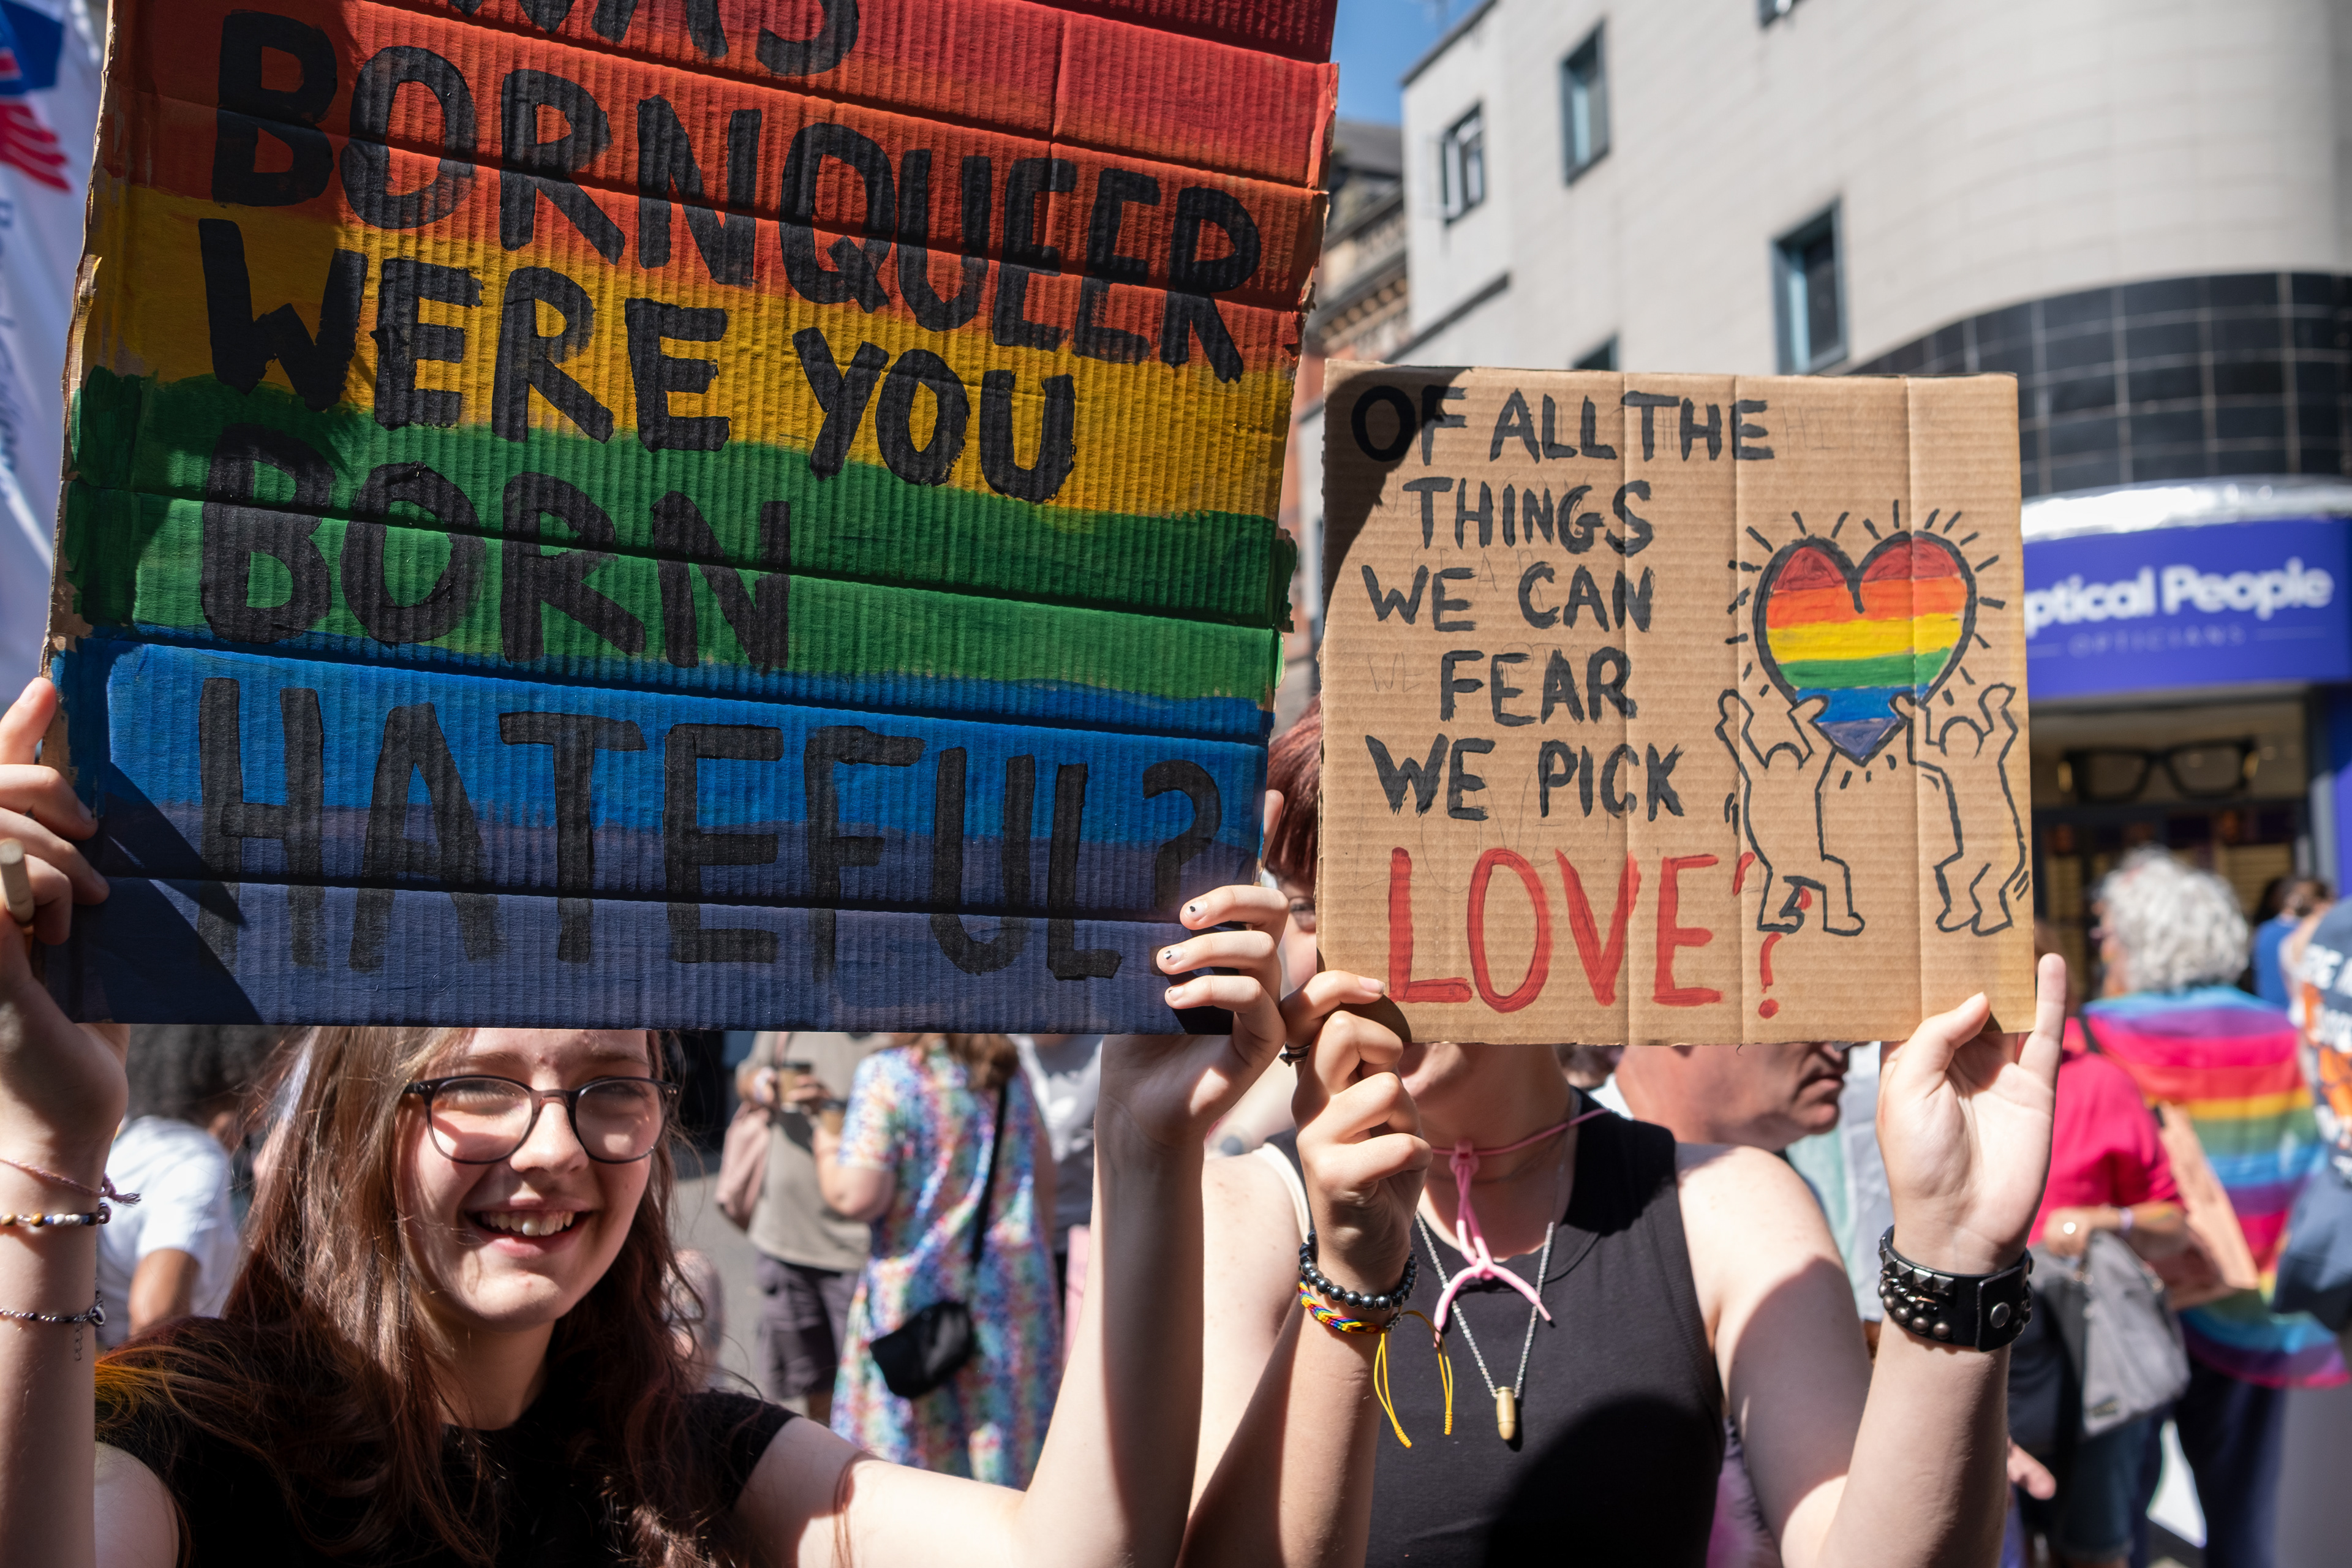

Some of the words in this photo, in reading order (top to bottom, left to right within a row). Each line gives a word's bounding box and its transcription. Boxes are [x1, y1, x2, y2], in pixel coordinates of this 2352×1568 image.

[212, 9, 762, 287] BORN
[778, 122, 1262, 384] QUEER
[198, 218, 731, 452] WERE
[792, 326, 1077, 504] YOU
[1351, 384, 1469, 466] OF
[1489, 388, 1618, 464] ALL
[1620, 390, 1776, 462] THE
[199, 423, 791, 675] BORN
[1402, 476, 1653, 557] THINGS
[1361, 564, 1477, 632] WE
[1517, 560, 1655, 633] CAN
[2023, 566, 2156, 639] ptical
[2162, 557, 2334, 620] People
[1440, 646, 1638, 728] FEAR
[1365, 733, 1496, 822] WE
[1537, 739, 1686, 822] PICK
[197, 676, 1223, 981] HATEFUL?
